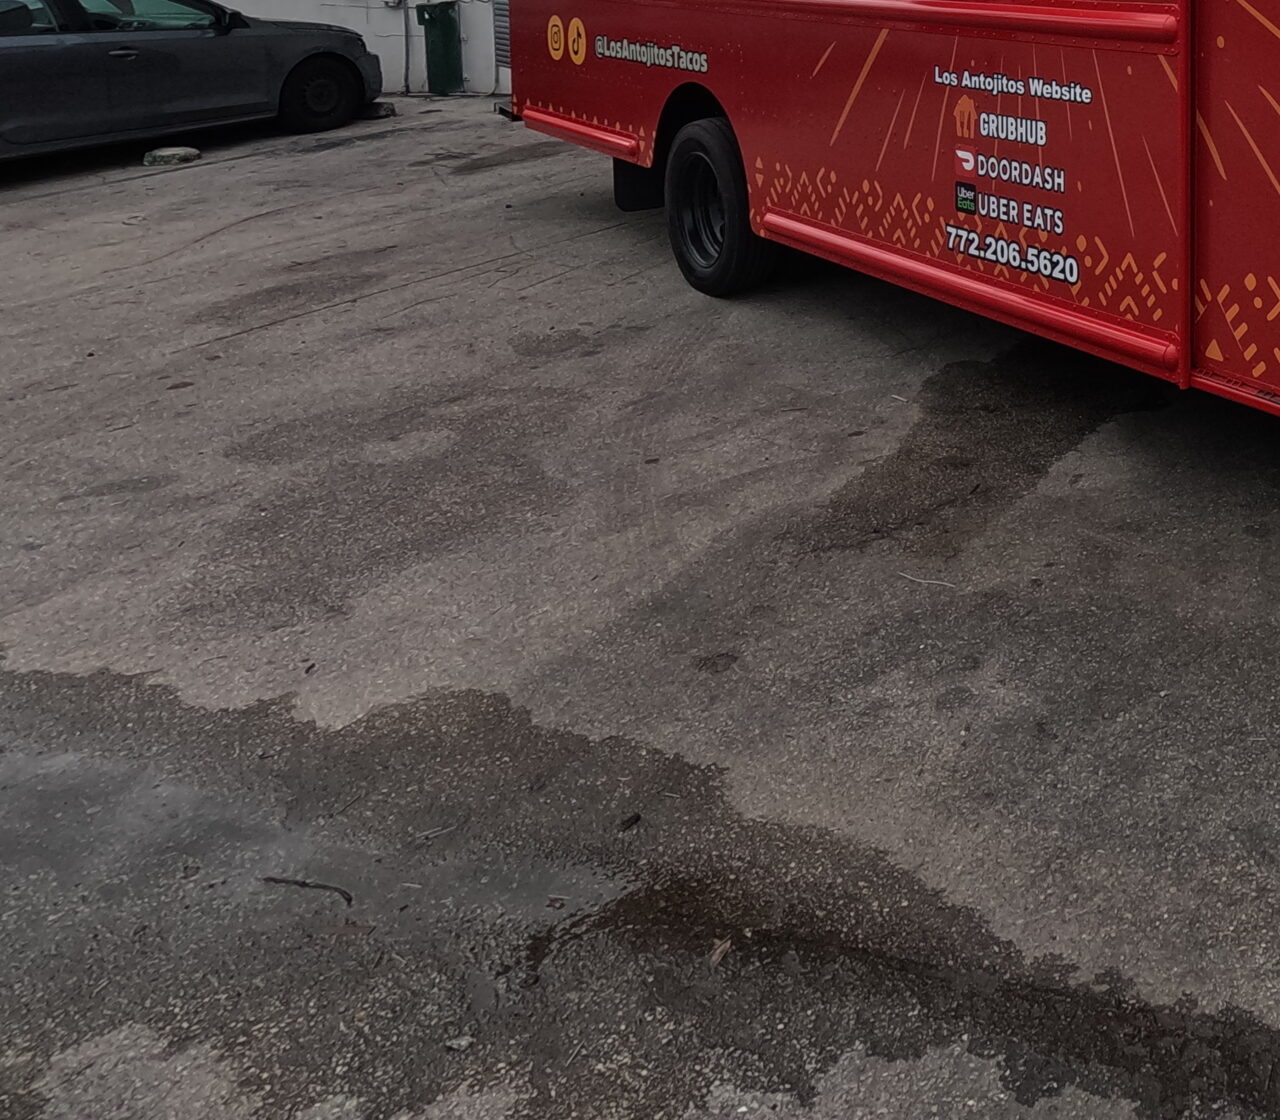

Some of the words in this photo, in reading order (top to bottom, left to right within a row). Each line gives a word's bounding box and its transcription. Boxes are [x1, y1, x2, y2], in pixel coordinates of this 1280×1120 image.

[594, 36, 709, 73] @LosAntojitosTacos
[934, 66, 958, 86] Los
[961, 71, 1025, 95] Antojitos
[1028, 78, 1093, 104] Website
[979, 112, 1048, 146] GRUBHUB
[977, 154, 1065, 193] DOORDASH
[956, 185, 976, 200] Uber
[956, 196, 976, 211] Eats
[977, 193, 1019, 223] UBER
[1022, 203, 1064, 234] EATS
[945, 226, 1079, 283] 772.206.5620
